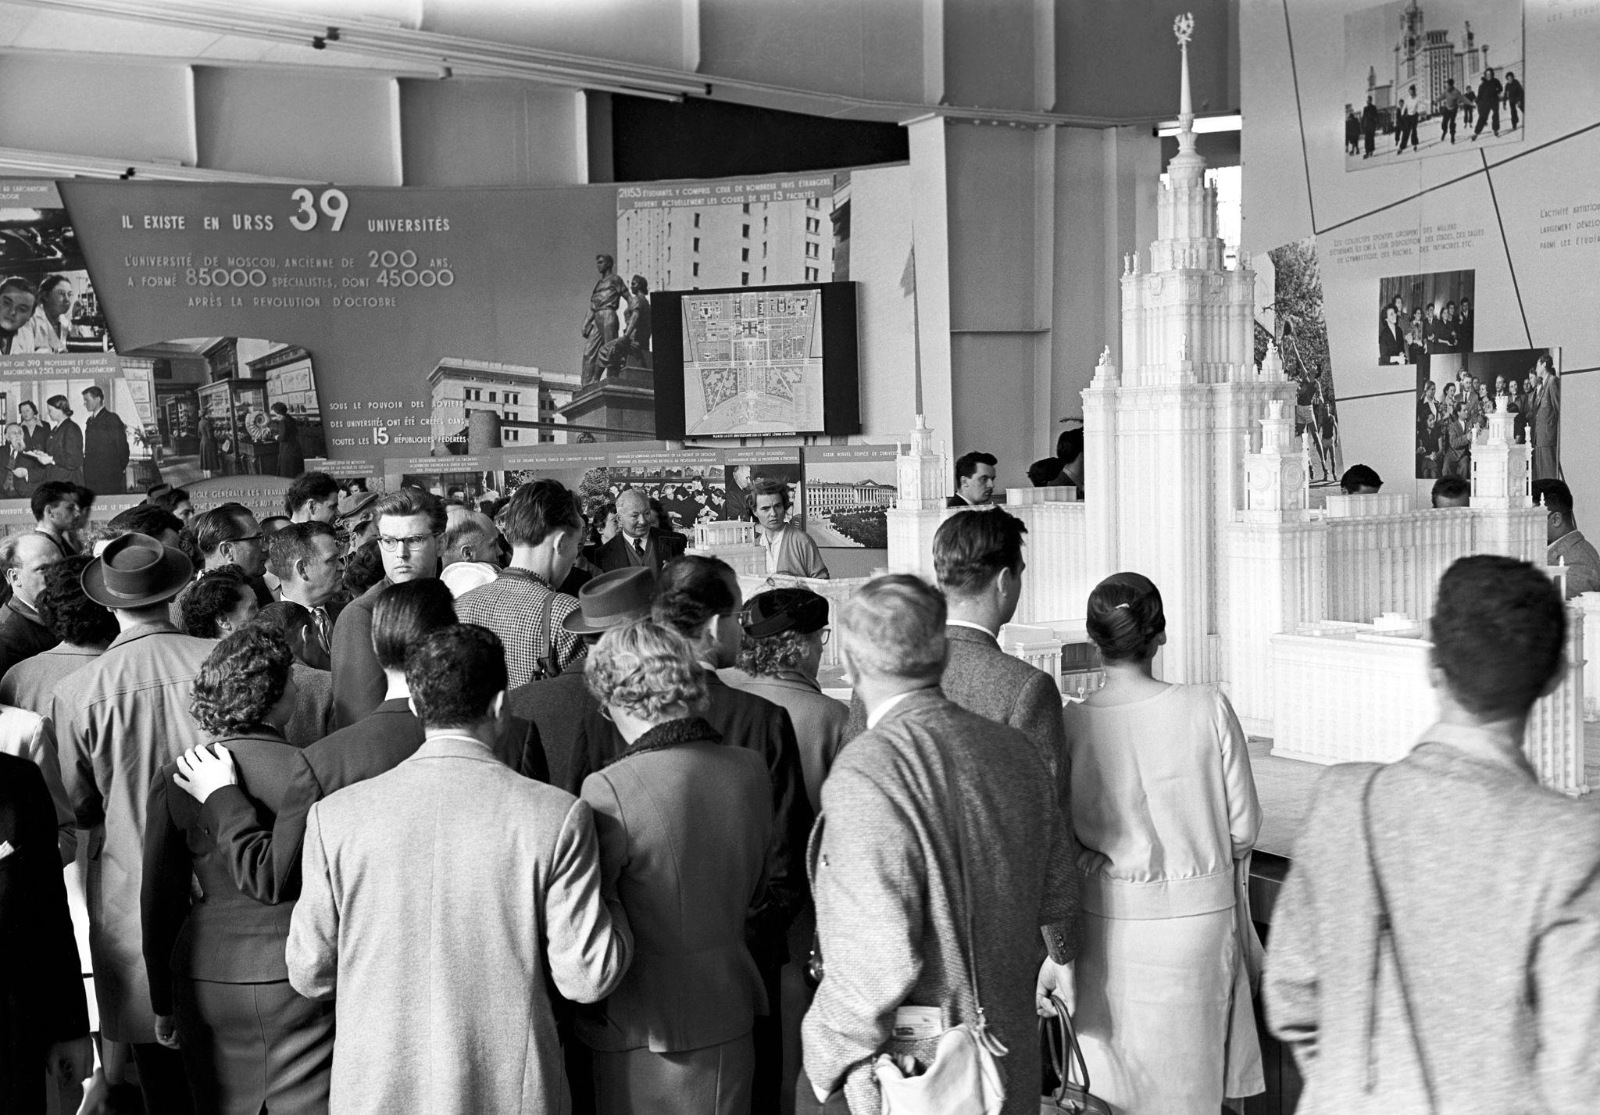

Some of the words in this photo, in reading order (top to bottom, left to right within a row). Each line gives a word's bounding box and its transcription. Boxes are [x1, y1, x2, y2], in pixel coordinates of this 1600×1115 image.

[721, 196, 744, 204] COURS
[774, 191, 783, 200] 13
[122, 215, 133, 229] IL
[144, 215, 186, 229] EXISTE
[204, 217, 219, 230] EN
[233, 215, 274, 231] URSS
[289, 188, 349, 232] 39
[368, 217, 450, 232] UNIVERSITÉS
[1561, 239, 1570, 247] LES
[125, 254, 192, 266] L'UNIVERSITÉ
[205, 256, 218, 267] DE
[228, 256, 280, 269] MOSCOU,
[285, 256, 334, 268] ANCIENNE
[341, 257, 355, 268] DE
[368, 250, 418, 269] 200
[128, 276, 133, 286] A
[142, 273, 177, 286] FORMÉ
[186, 269, 267, 287] 85000
[343, 276, 370, 287] DONT
[376, 269, 454, 287] 45000
[188, 292, 222, 307] APRÈS
[231, 297, 243, 307] LA
[333, 296, 397, 307] D'OCTOBRE
[368, 401, 403, 409] POUVOIR
[347, 418, 383, 427] UNIVERSITÉS
[405, 416, 415, 426] ÉTÉ
[332, 438, 355, 446] TOUTES
[373, 427, 389, 445] 15
[394, 434, 434, 443] RÉPUBLIQUES
[212, 489, 244, 498] GÉNÉRALE
